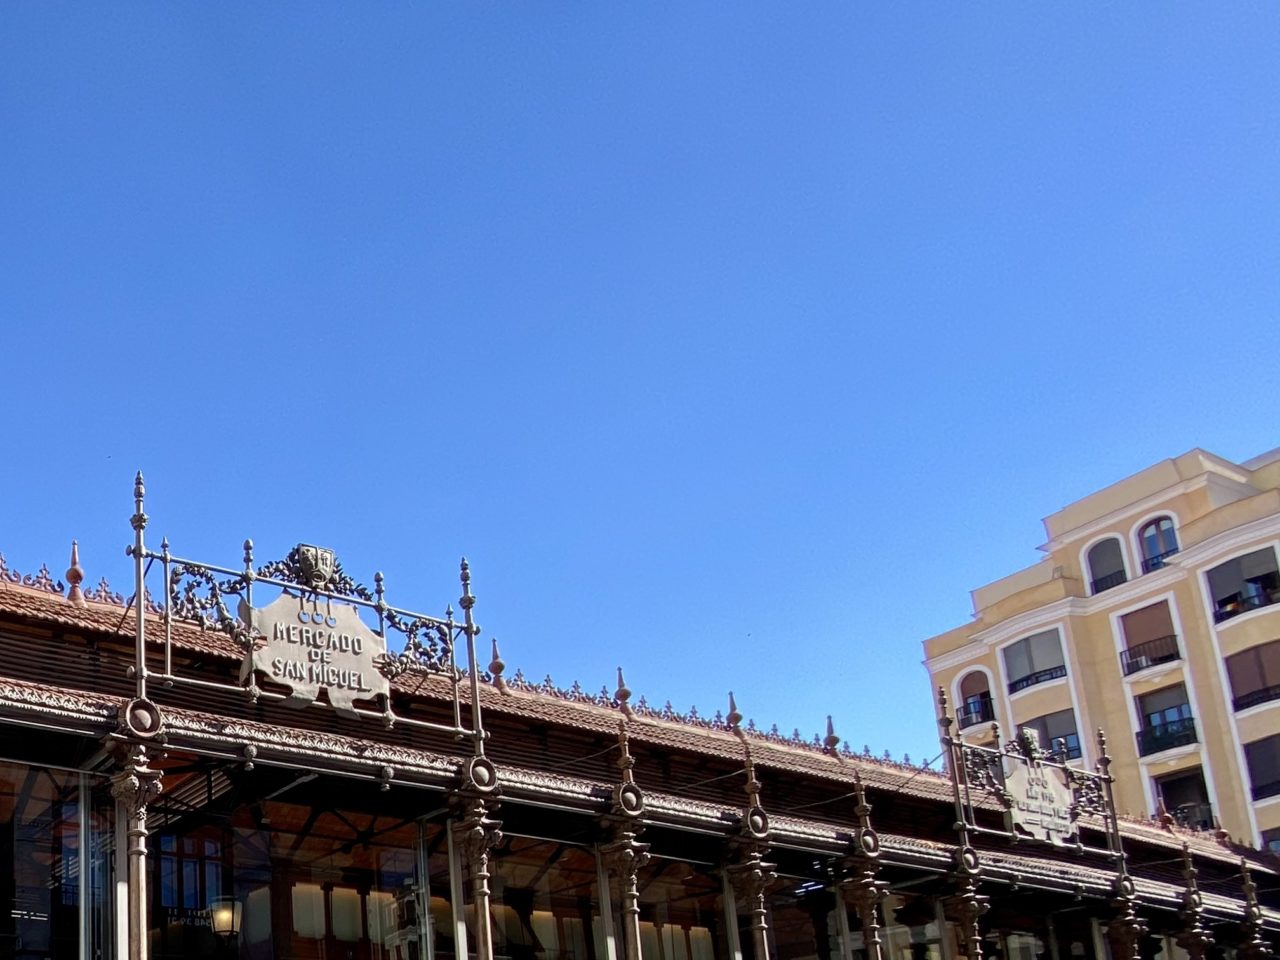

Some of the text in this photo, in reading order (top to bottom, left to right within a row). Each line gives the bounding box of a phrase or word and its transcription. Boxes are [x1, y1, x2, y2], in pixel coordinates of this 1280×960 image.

[274, 621, 364, 655] MERCADO
[272, 657, 306, 682] SAN
[308, 648, 332, 664] DE
[309, 663, 372, 693] MIGUEL
